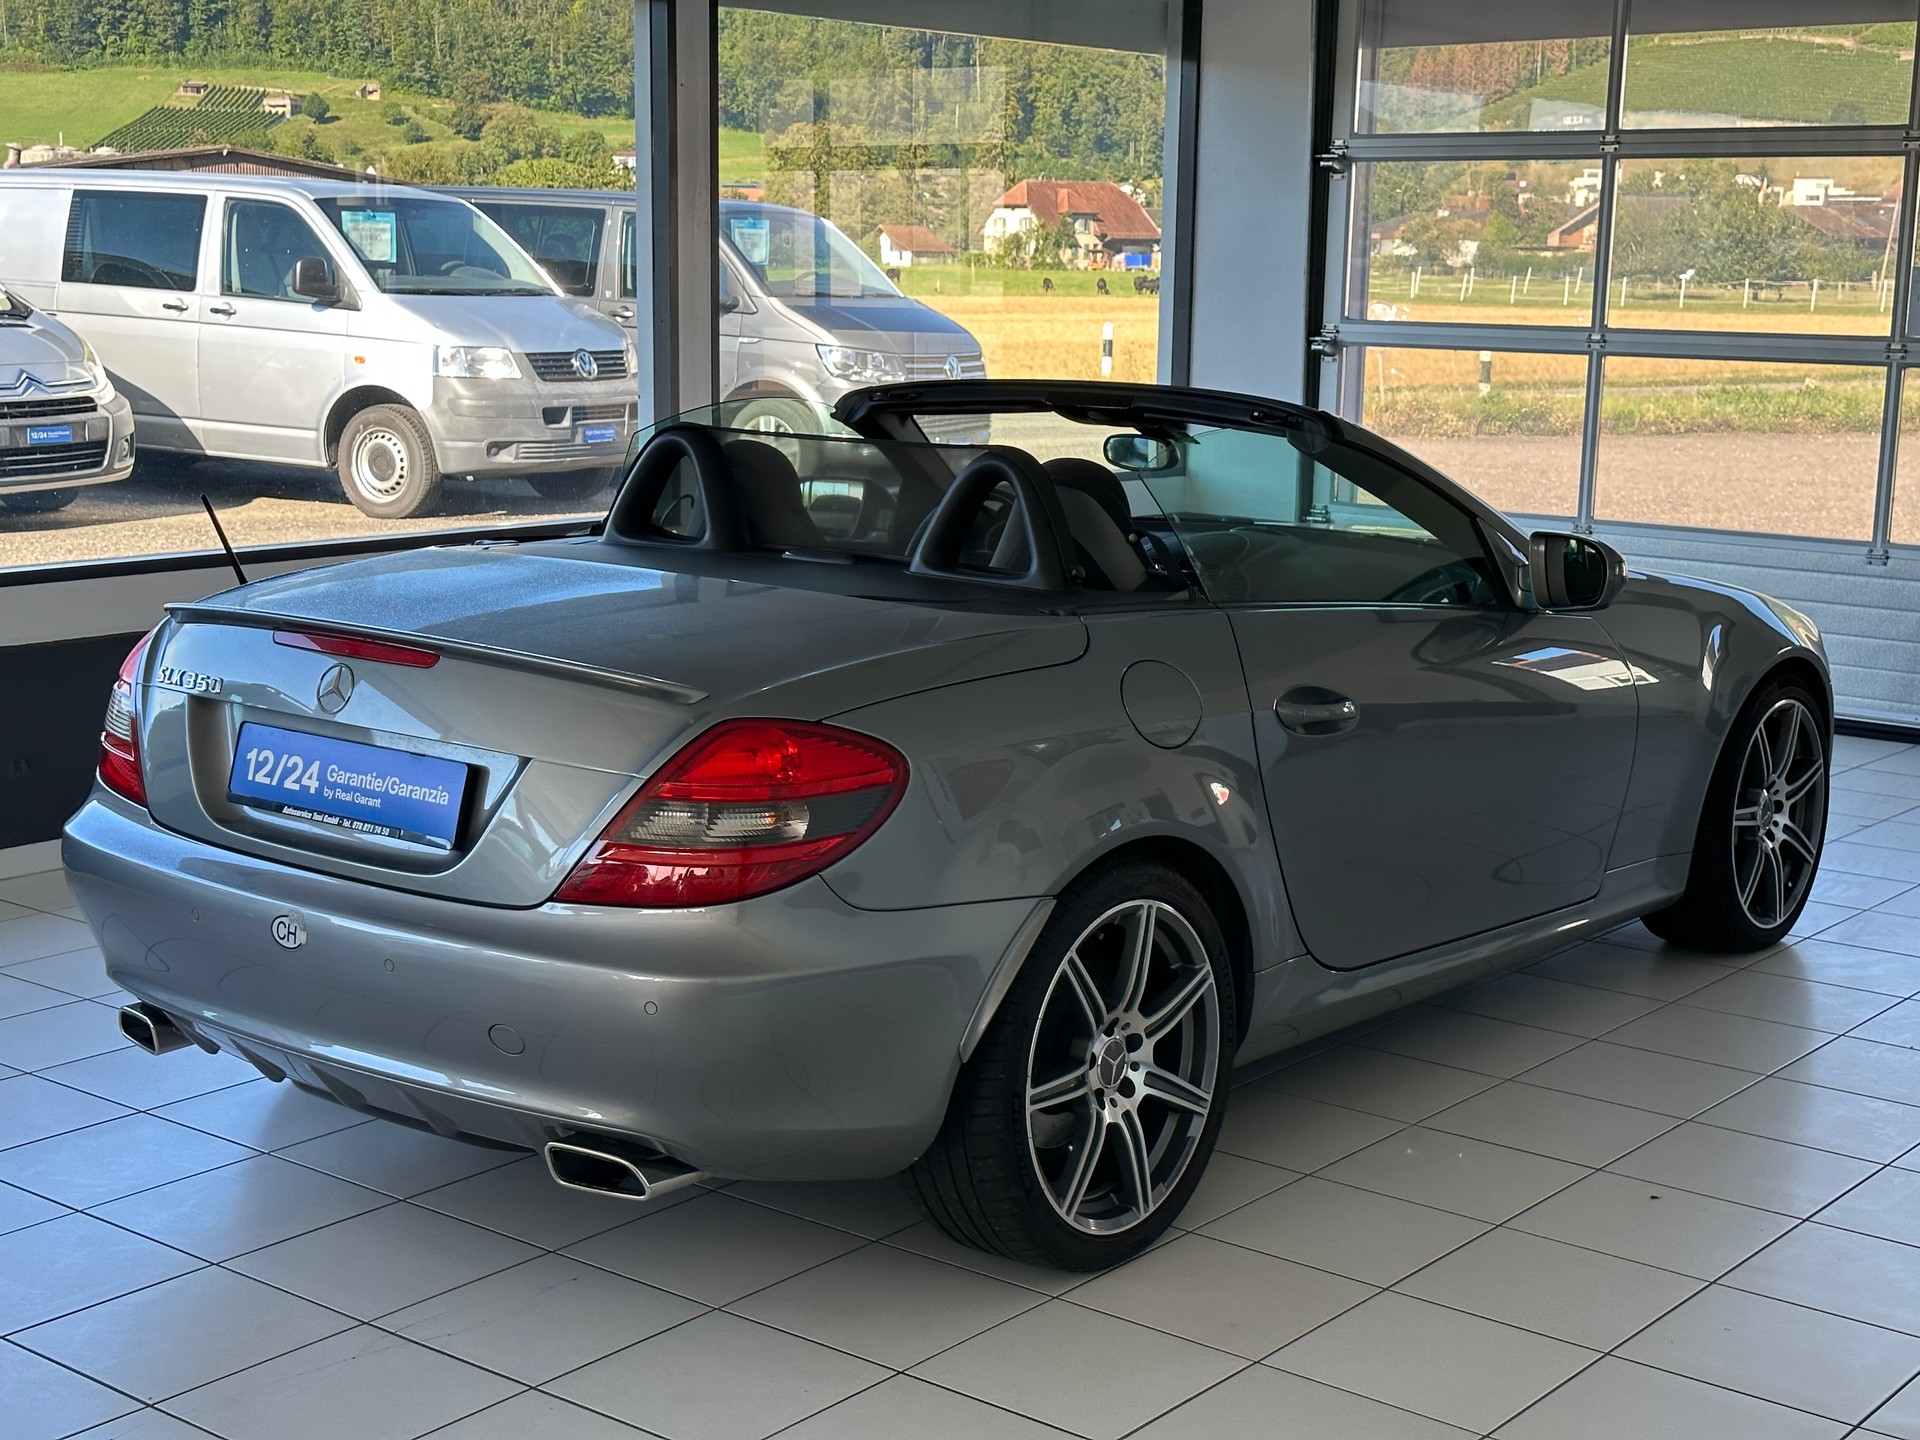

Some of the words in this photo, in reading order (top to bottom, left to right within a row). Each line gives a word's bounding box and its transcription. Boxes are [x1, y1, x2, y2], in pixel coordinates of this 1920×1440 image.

[246, 748, 320, 794] 12/24
[327, 764, 449, 805] Garantie/Garanzia
[323, 786, 334, 799] by
[335, 788, 353, 802] Real
[354, 792, 382, 808] Garant
[282, 805, 312, 819] Autoservice
[276, 920, 298, 945] CH
